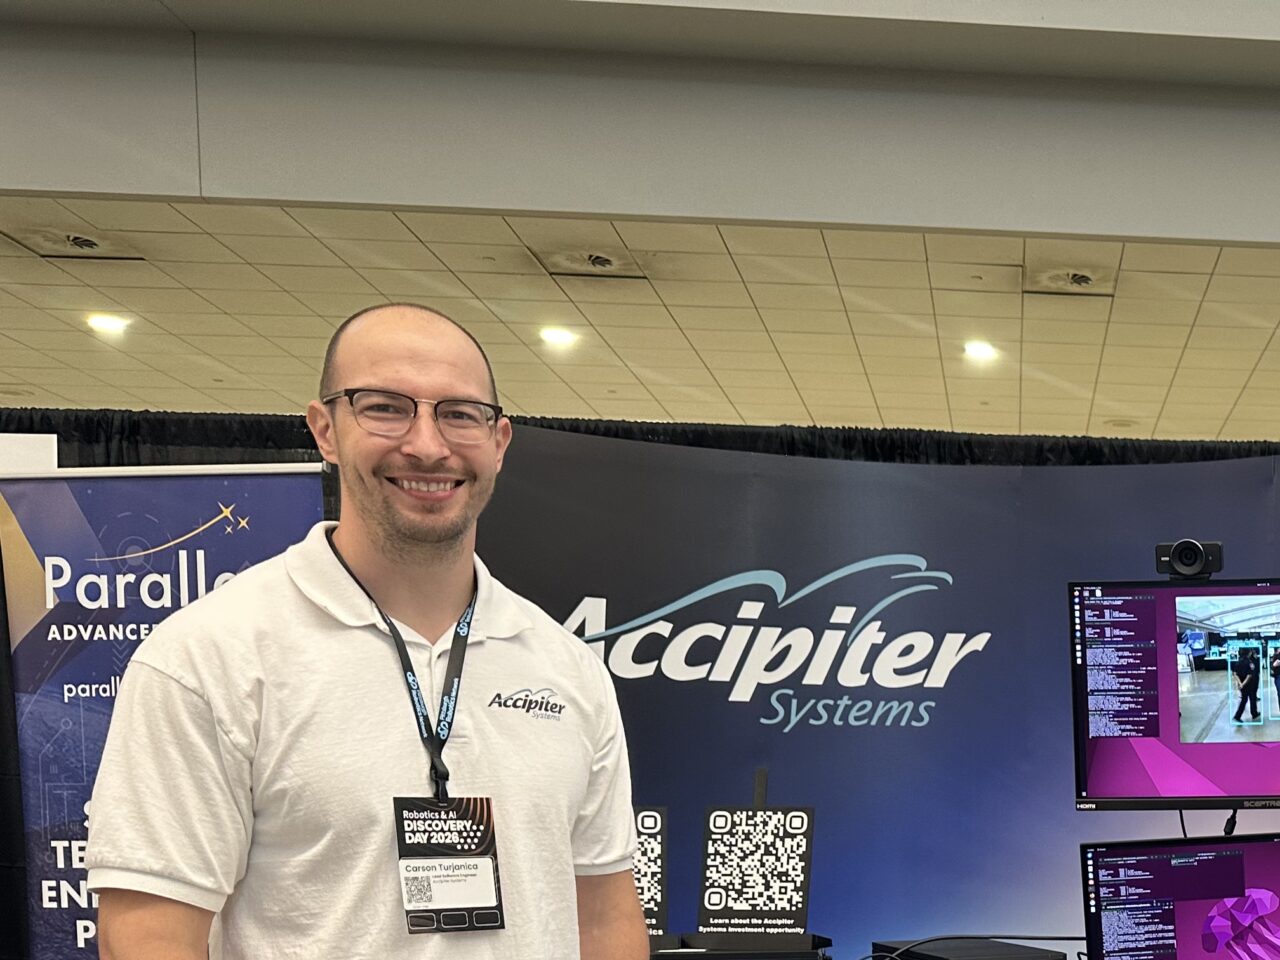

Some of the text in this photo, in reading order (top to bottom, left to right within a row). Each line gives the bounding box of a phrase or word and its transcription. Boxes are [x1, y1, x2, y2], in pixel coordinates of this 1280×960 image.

[563, 596, 992, 703] Accipiter
[488, 692, 566, 715] Accipiter
[532, 710, 561, 722] Systems
[759, 688, 936, 734] Systems
[402, 810, 457, 820] Robotics & AI
[403, 820, 473, 832] DISCOVERY
[405, 832, 460, 844] DAY 2026
[405, 864, 437, 873] Carson
[698, 925, 727, 934] Systems
[765, 926, 805, 935] opportunity
